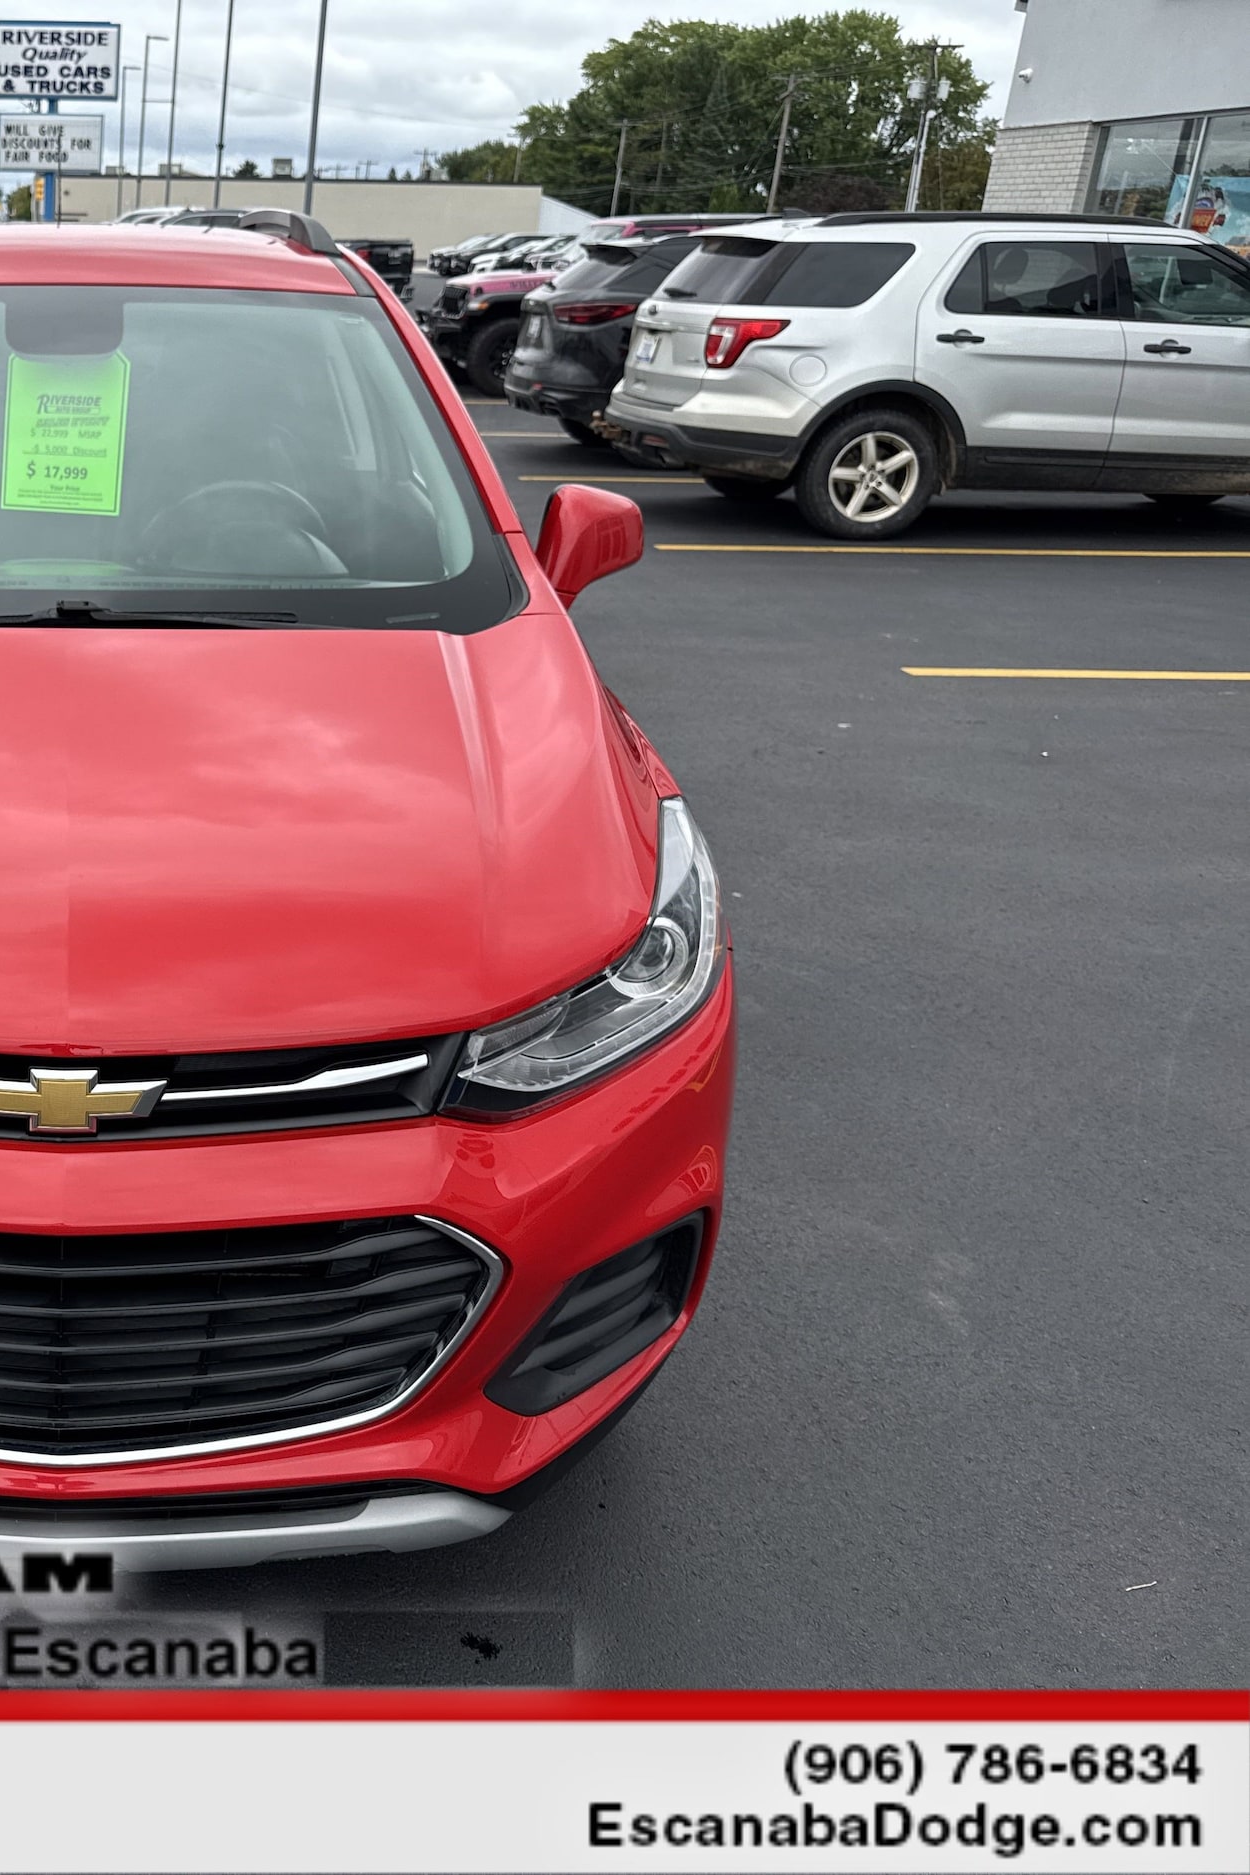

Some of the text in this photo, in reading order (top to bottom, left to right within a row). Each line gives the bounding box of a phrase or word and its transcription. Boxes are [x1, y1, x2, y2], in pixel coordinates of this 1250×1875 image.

[2, 30, 109, 46] RIVERSIDE
[22, 47, 87, 62] Quality
[58, 66, 111, 79] CARS
[3, 79, 104, 94] & TRUCKS
[4, 125, 65, 137] WILL GIVE
[1, 137, 92, 150] DISCOUNTS FOR
[4, 151, 69, 163] FAIR FOOD
[36, 394, 102, 414] RIVERSIDE
[73, 446, 107, 458] Discount
[26, 459, 88, 481] $ 17,999
